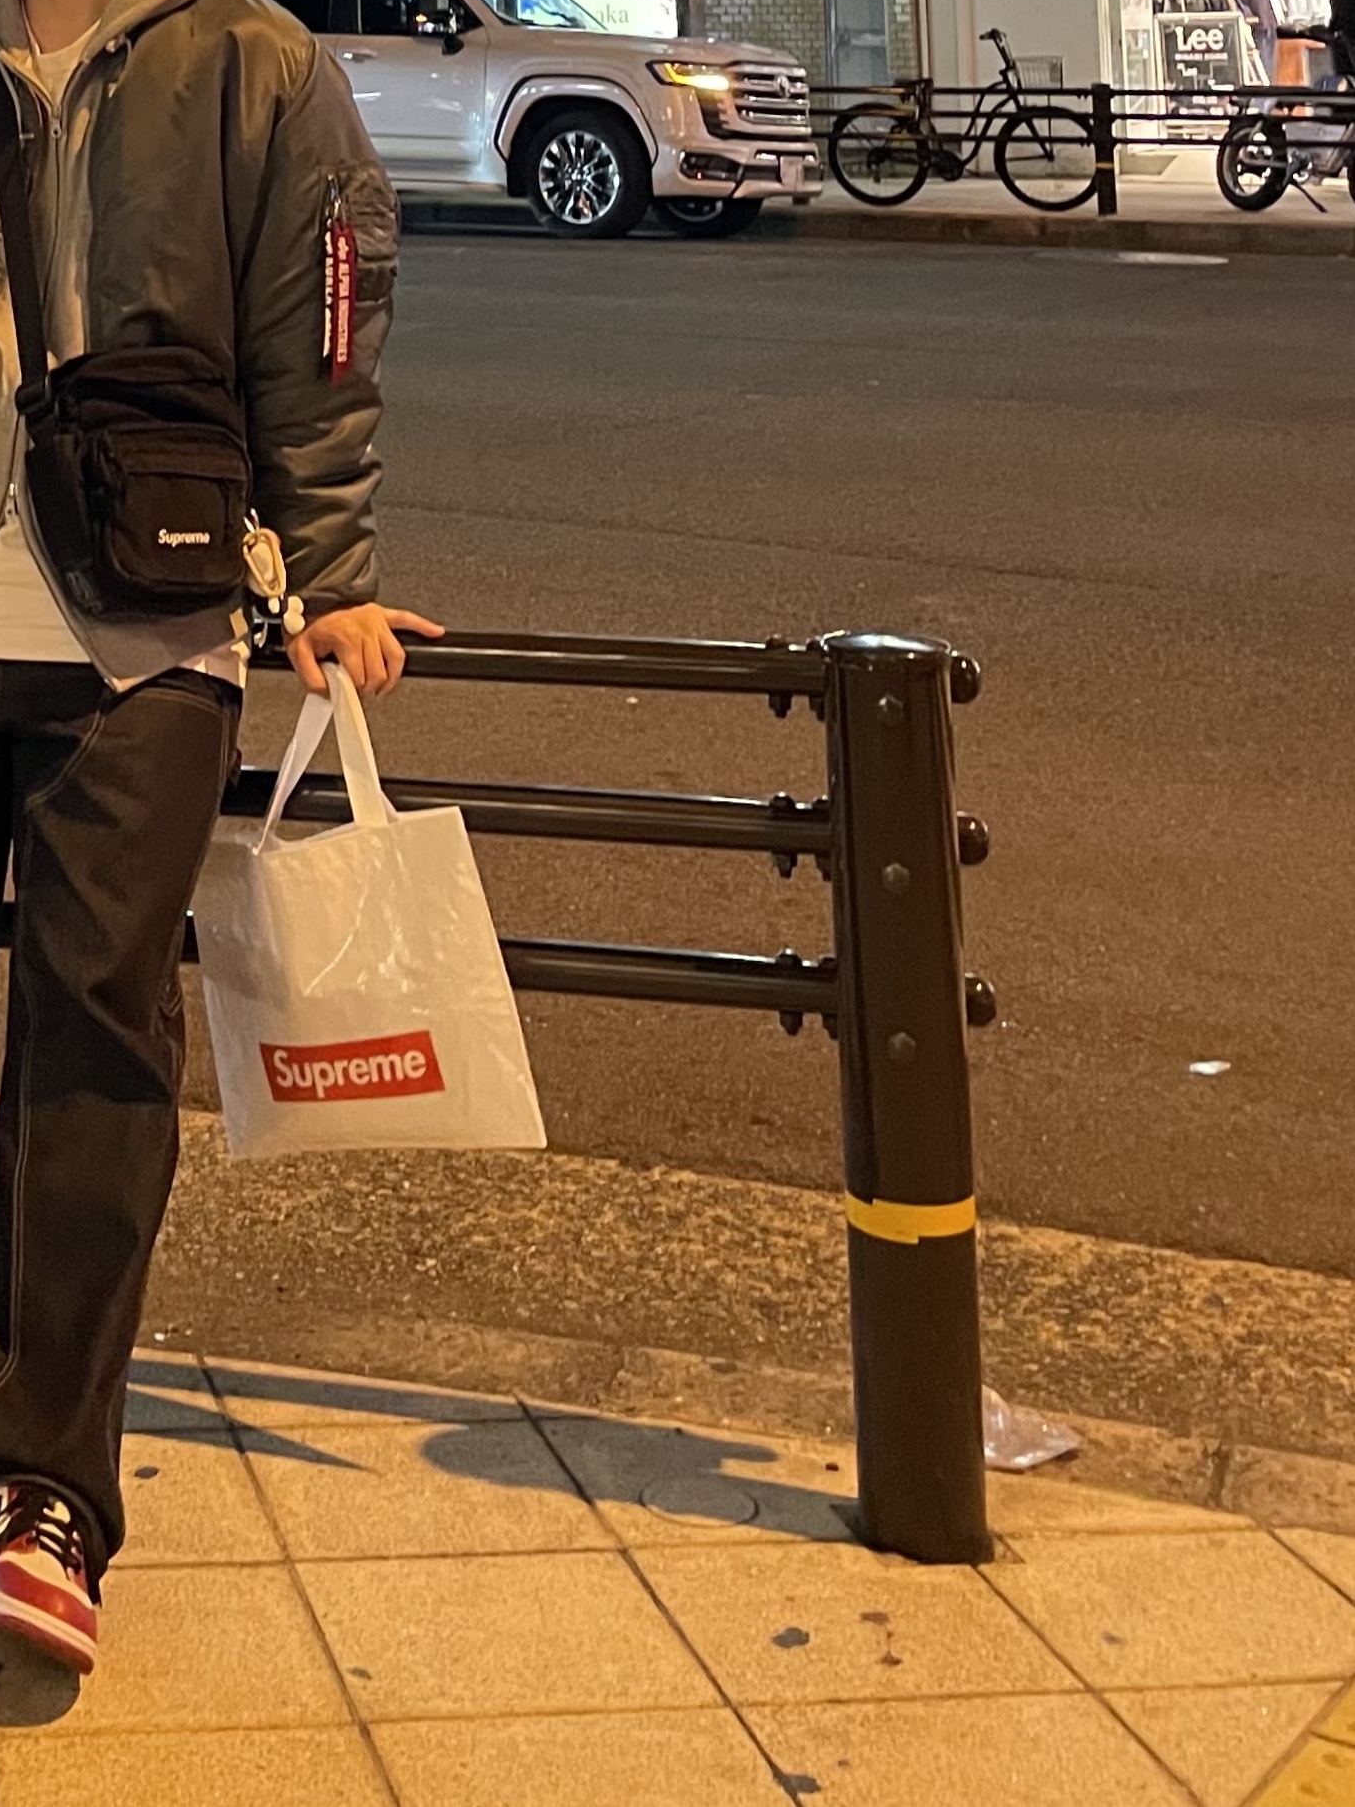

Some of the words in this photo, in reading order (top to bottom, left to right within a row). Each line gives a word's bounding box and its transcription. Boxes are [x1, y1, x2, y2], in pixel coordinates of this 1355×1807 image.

[1175, 26, 1224, 51] Lee
[158, 528, 211, 548] Supreme
[272, 1048, 427, 1100] Supreme
